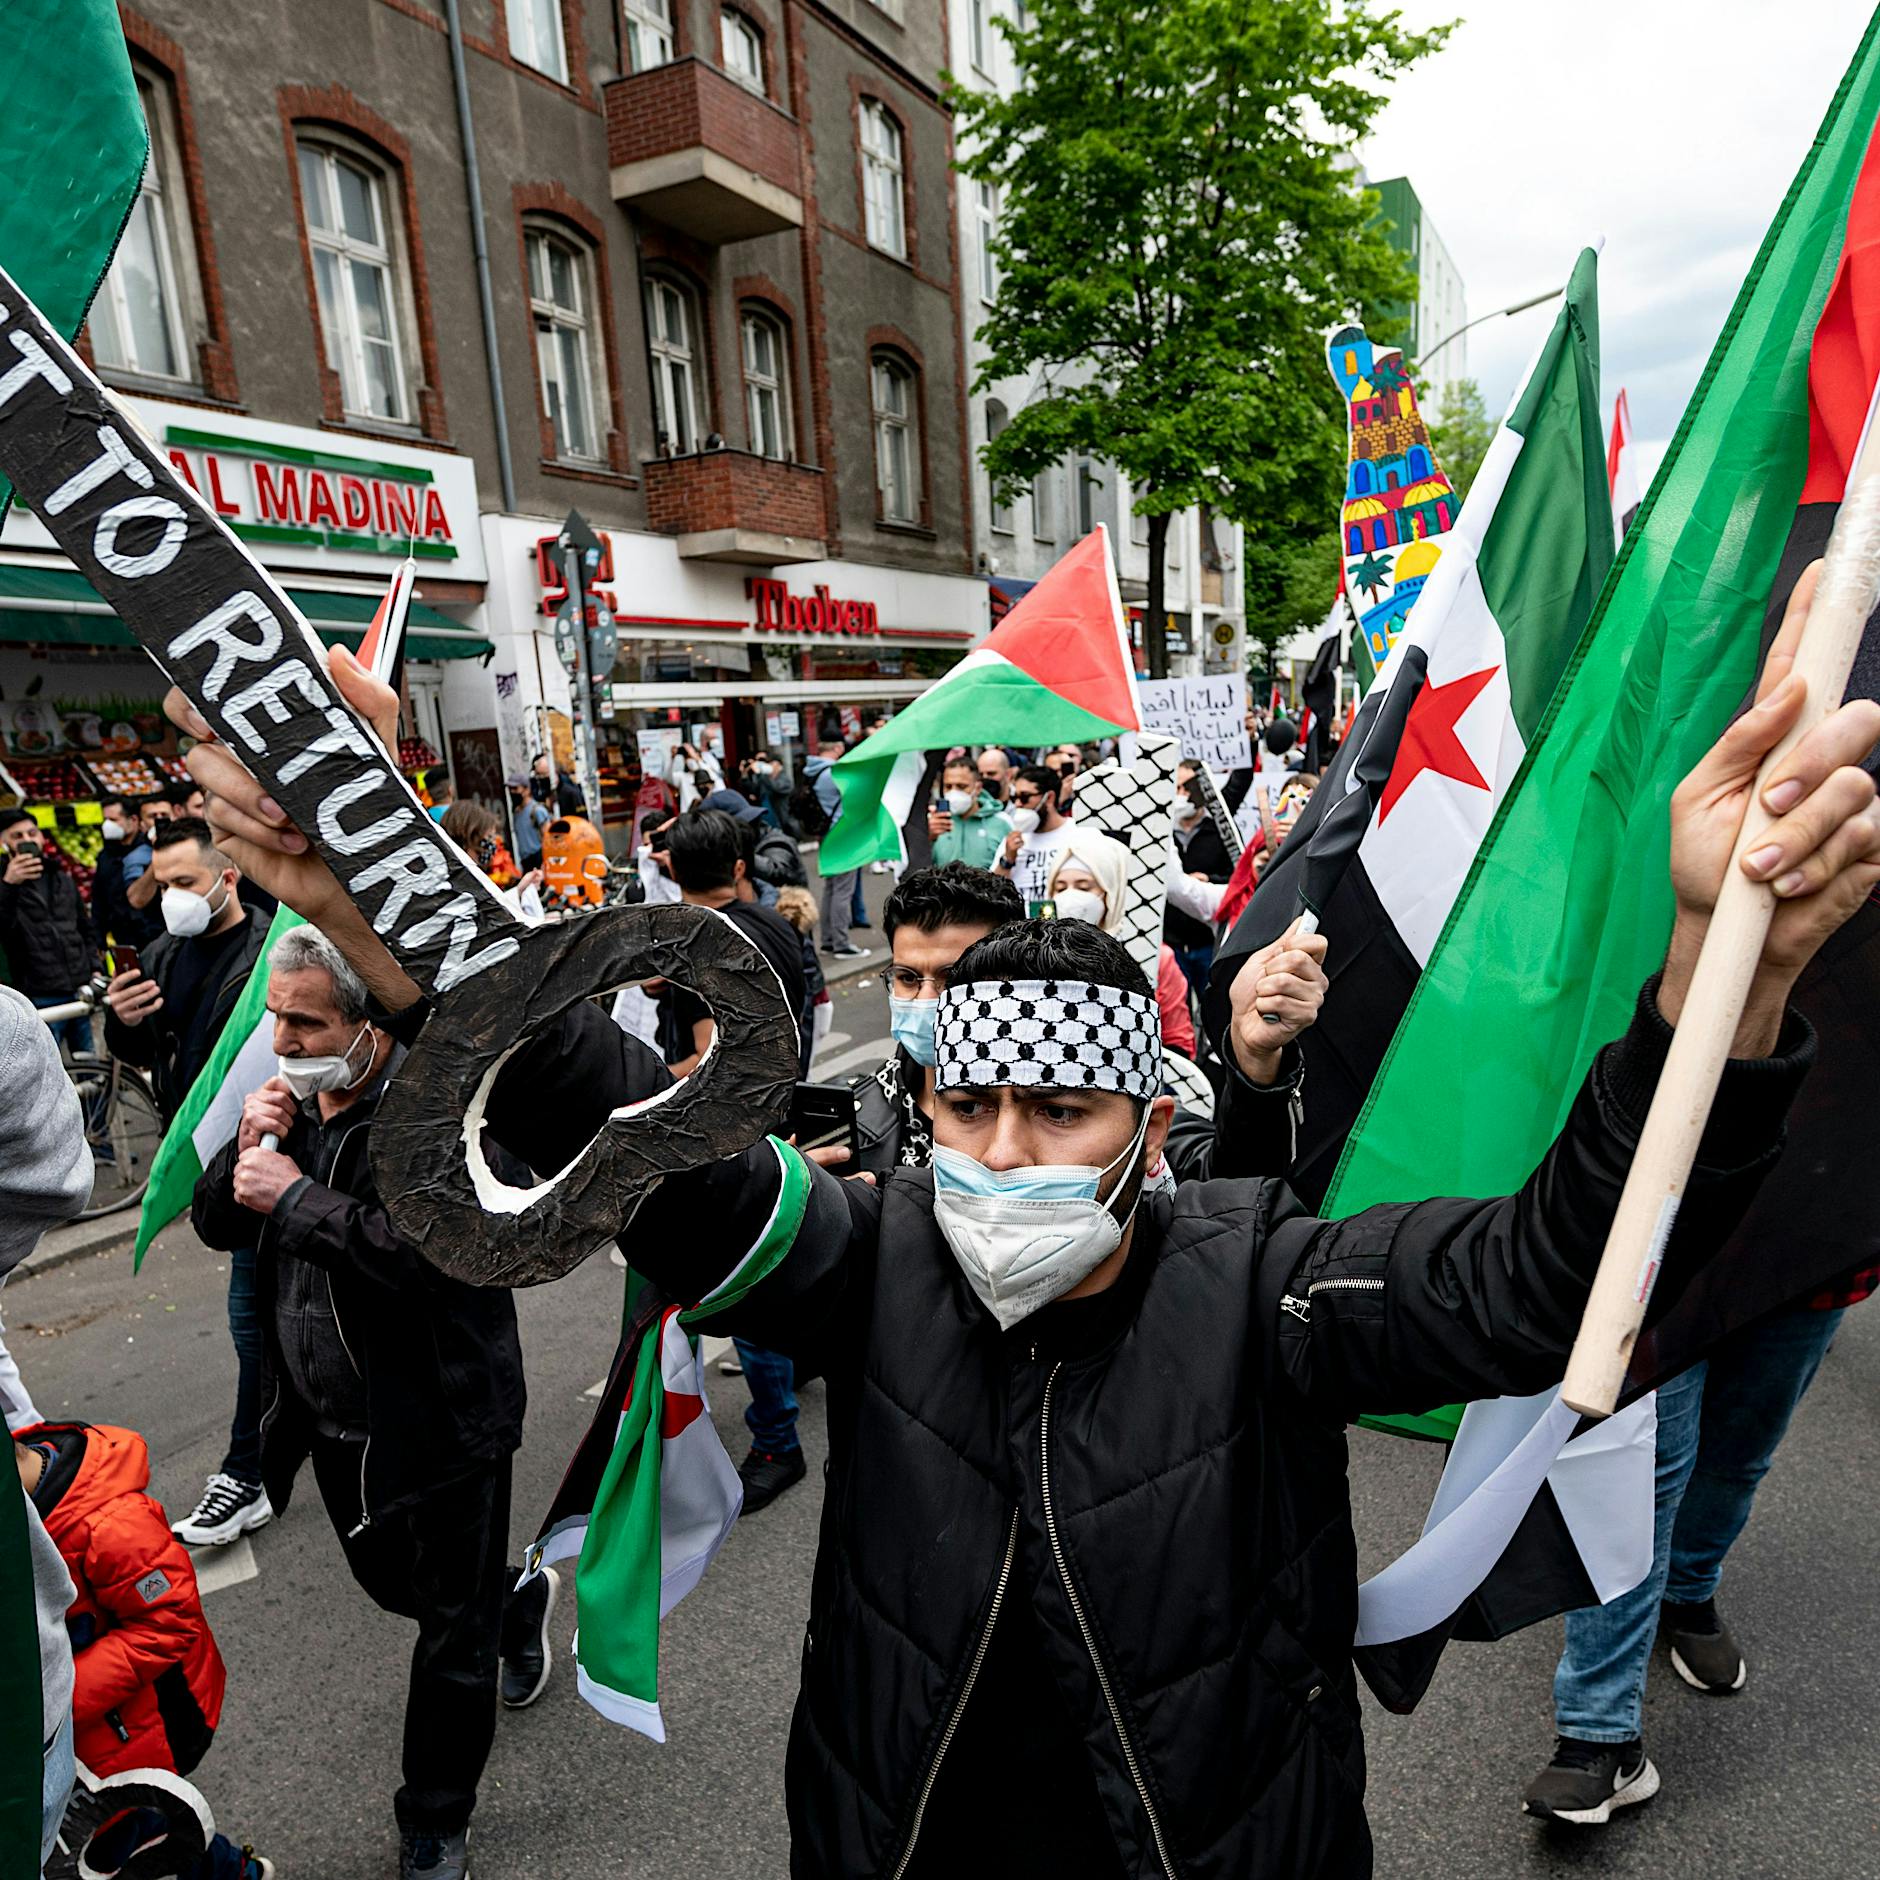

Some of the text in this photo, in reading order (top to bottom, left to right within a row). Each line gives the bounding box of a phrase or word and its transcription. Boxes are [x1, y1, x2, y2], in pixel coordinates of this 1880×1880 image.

[253, 461, 453, 541] MADINA
[745, 577, 879, 636] Thoben
[0, 302, 74, 407] T
[43, 425, 188, 579] TO
[166, 590, 521, 993] RETURN
[1208, 798, 1241, 865] PALESTIN
